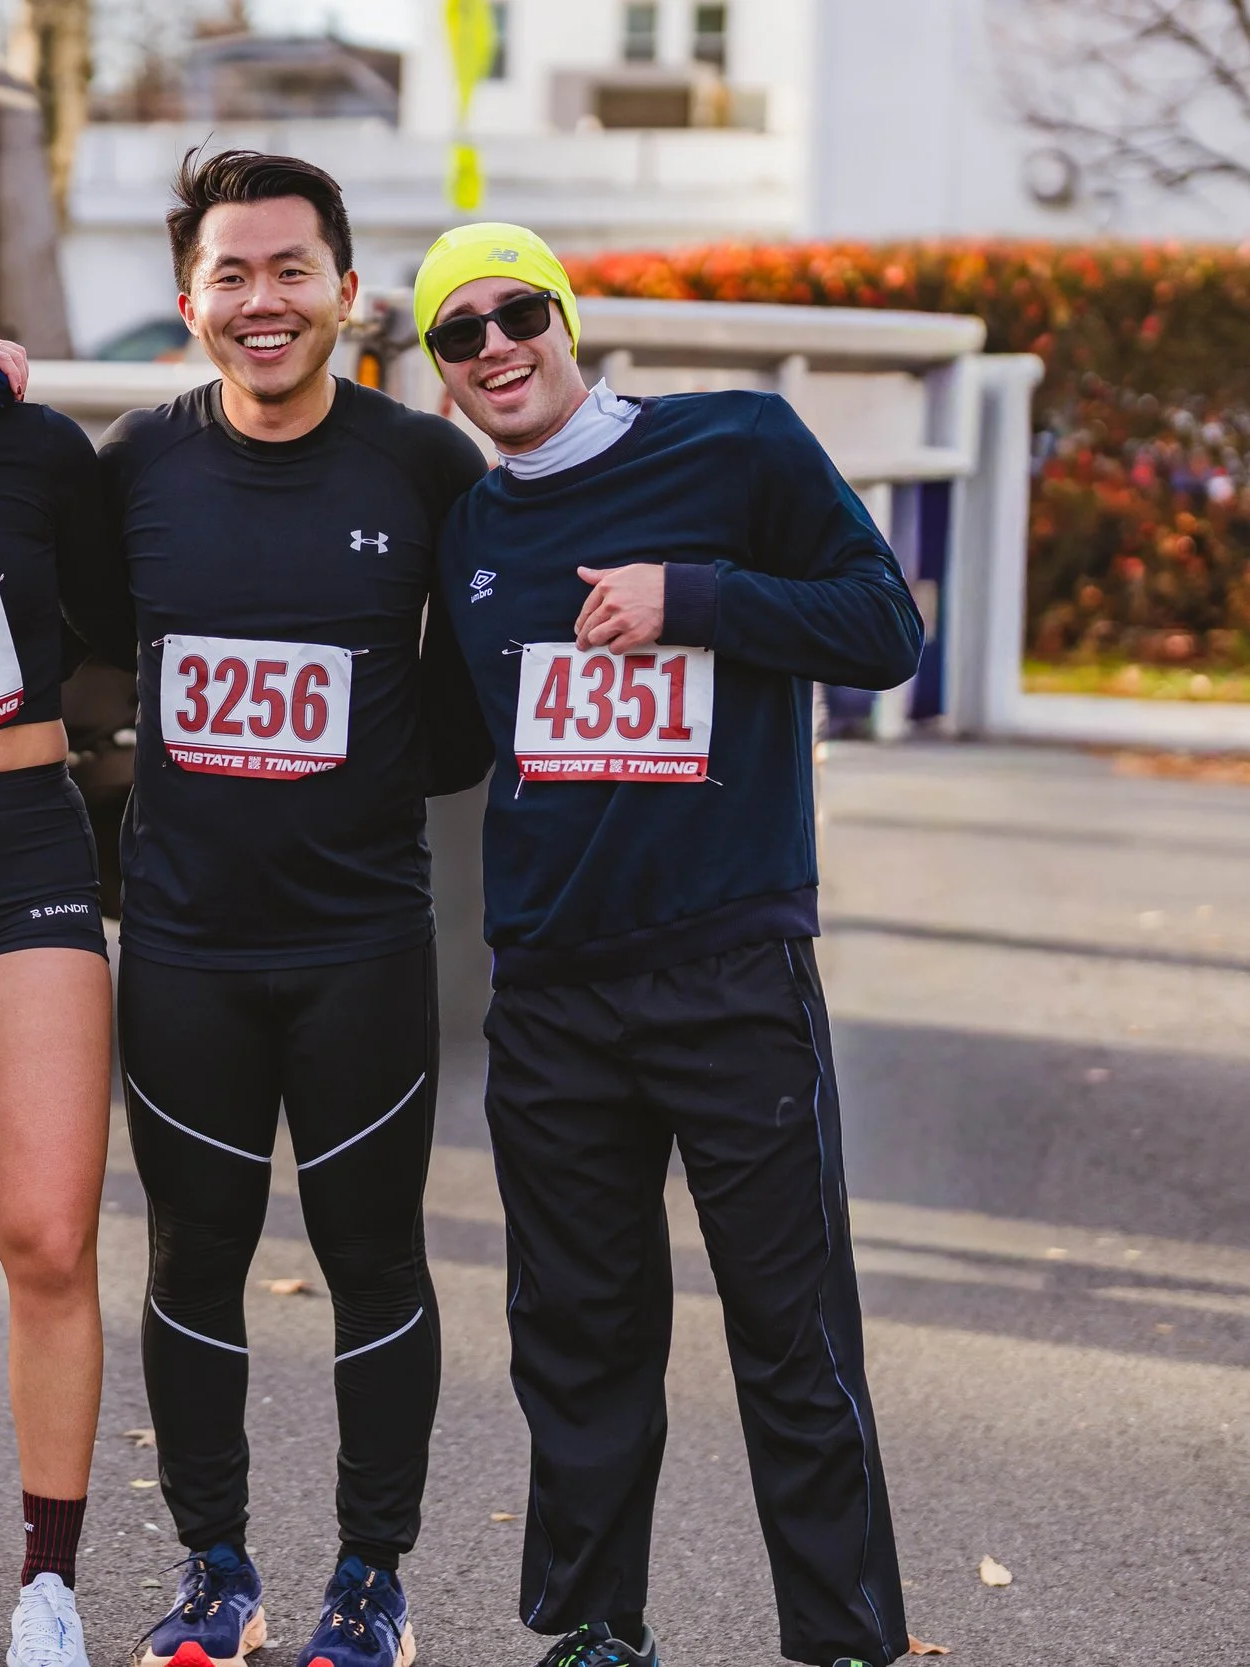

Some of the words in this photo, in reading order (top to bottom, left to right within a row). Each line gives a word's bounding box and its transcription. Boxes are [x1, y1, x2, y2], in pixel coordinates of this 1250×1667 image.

[175, 654, 330, 743] 3256
[534, 654, 693, 741] 4351
[169, 749, 245, 768] TRISTATE
[264, 757, 337, 773] TIMING
[521, 760, 606, 773] TRISTATE
[627, 760, 699, 774] TIMING
[44, 904, 89, 916] BANDIT
